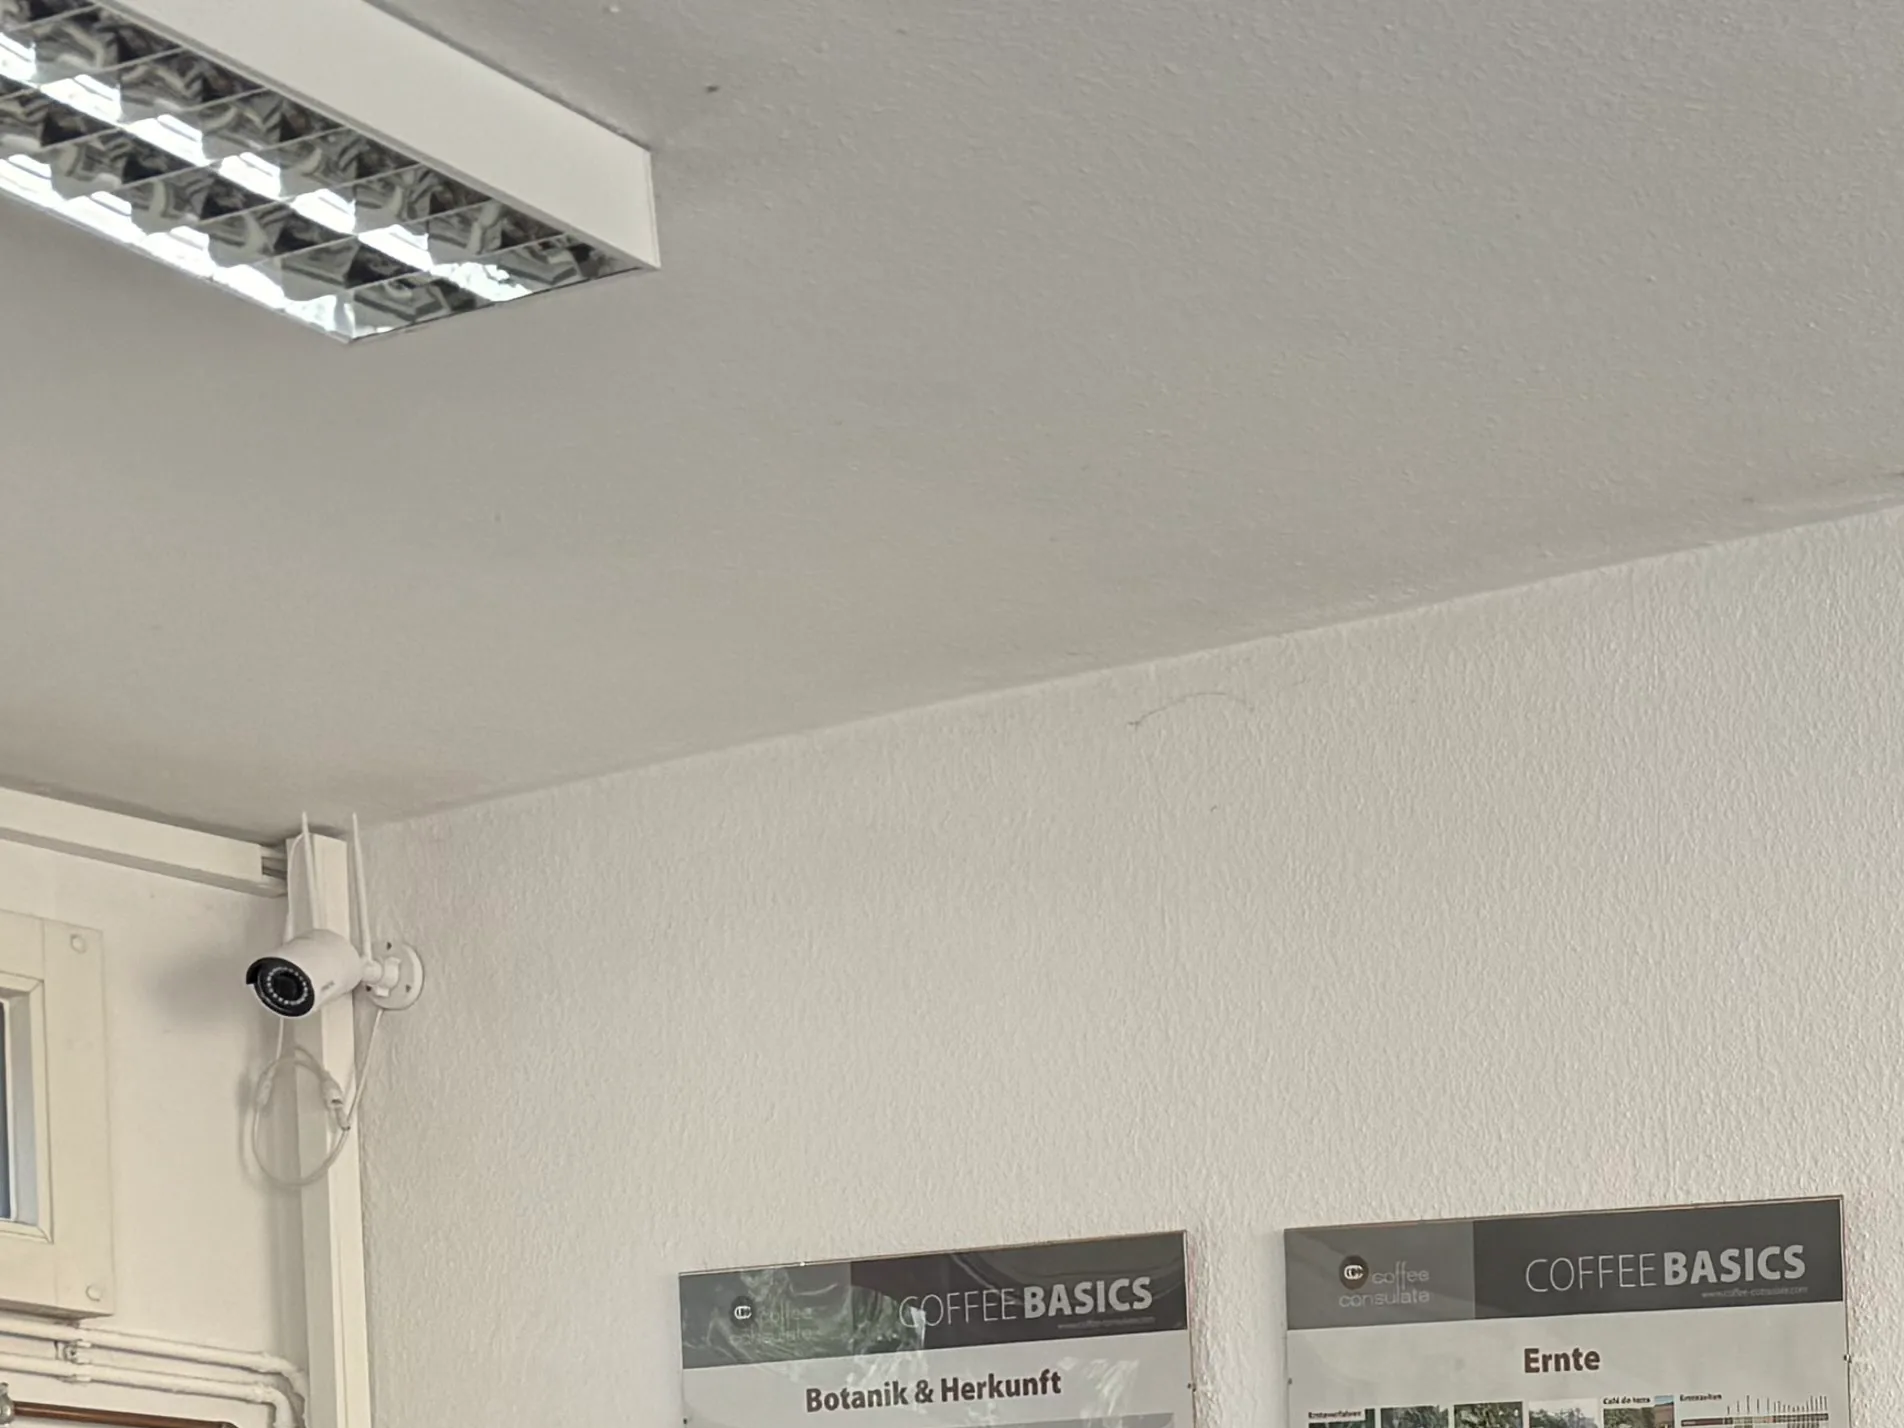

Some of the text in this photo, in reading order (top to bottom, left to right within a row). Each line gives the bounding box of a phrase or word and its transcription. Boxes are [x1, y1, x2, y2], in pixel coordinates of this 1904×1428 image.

[1372, 1262, 1429, 1290] coffee
[1526, 1245, 1806, 1293] COFFEE BASICS
[900, 1276, 1152, 1327] COFFEE BASICS
[1339, 1288, 1430, 1308] consulate
[1524, 1347, 1601, 1373] Ernte
[806, 1369, 1062, 1413] Botanik & Herkunft
